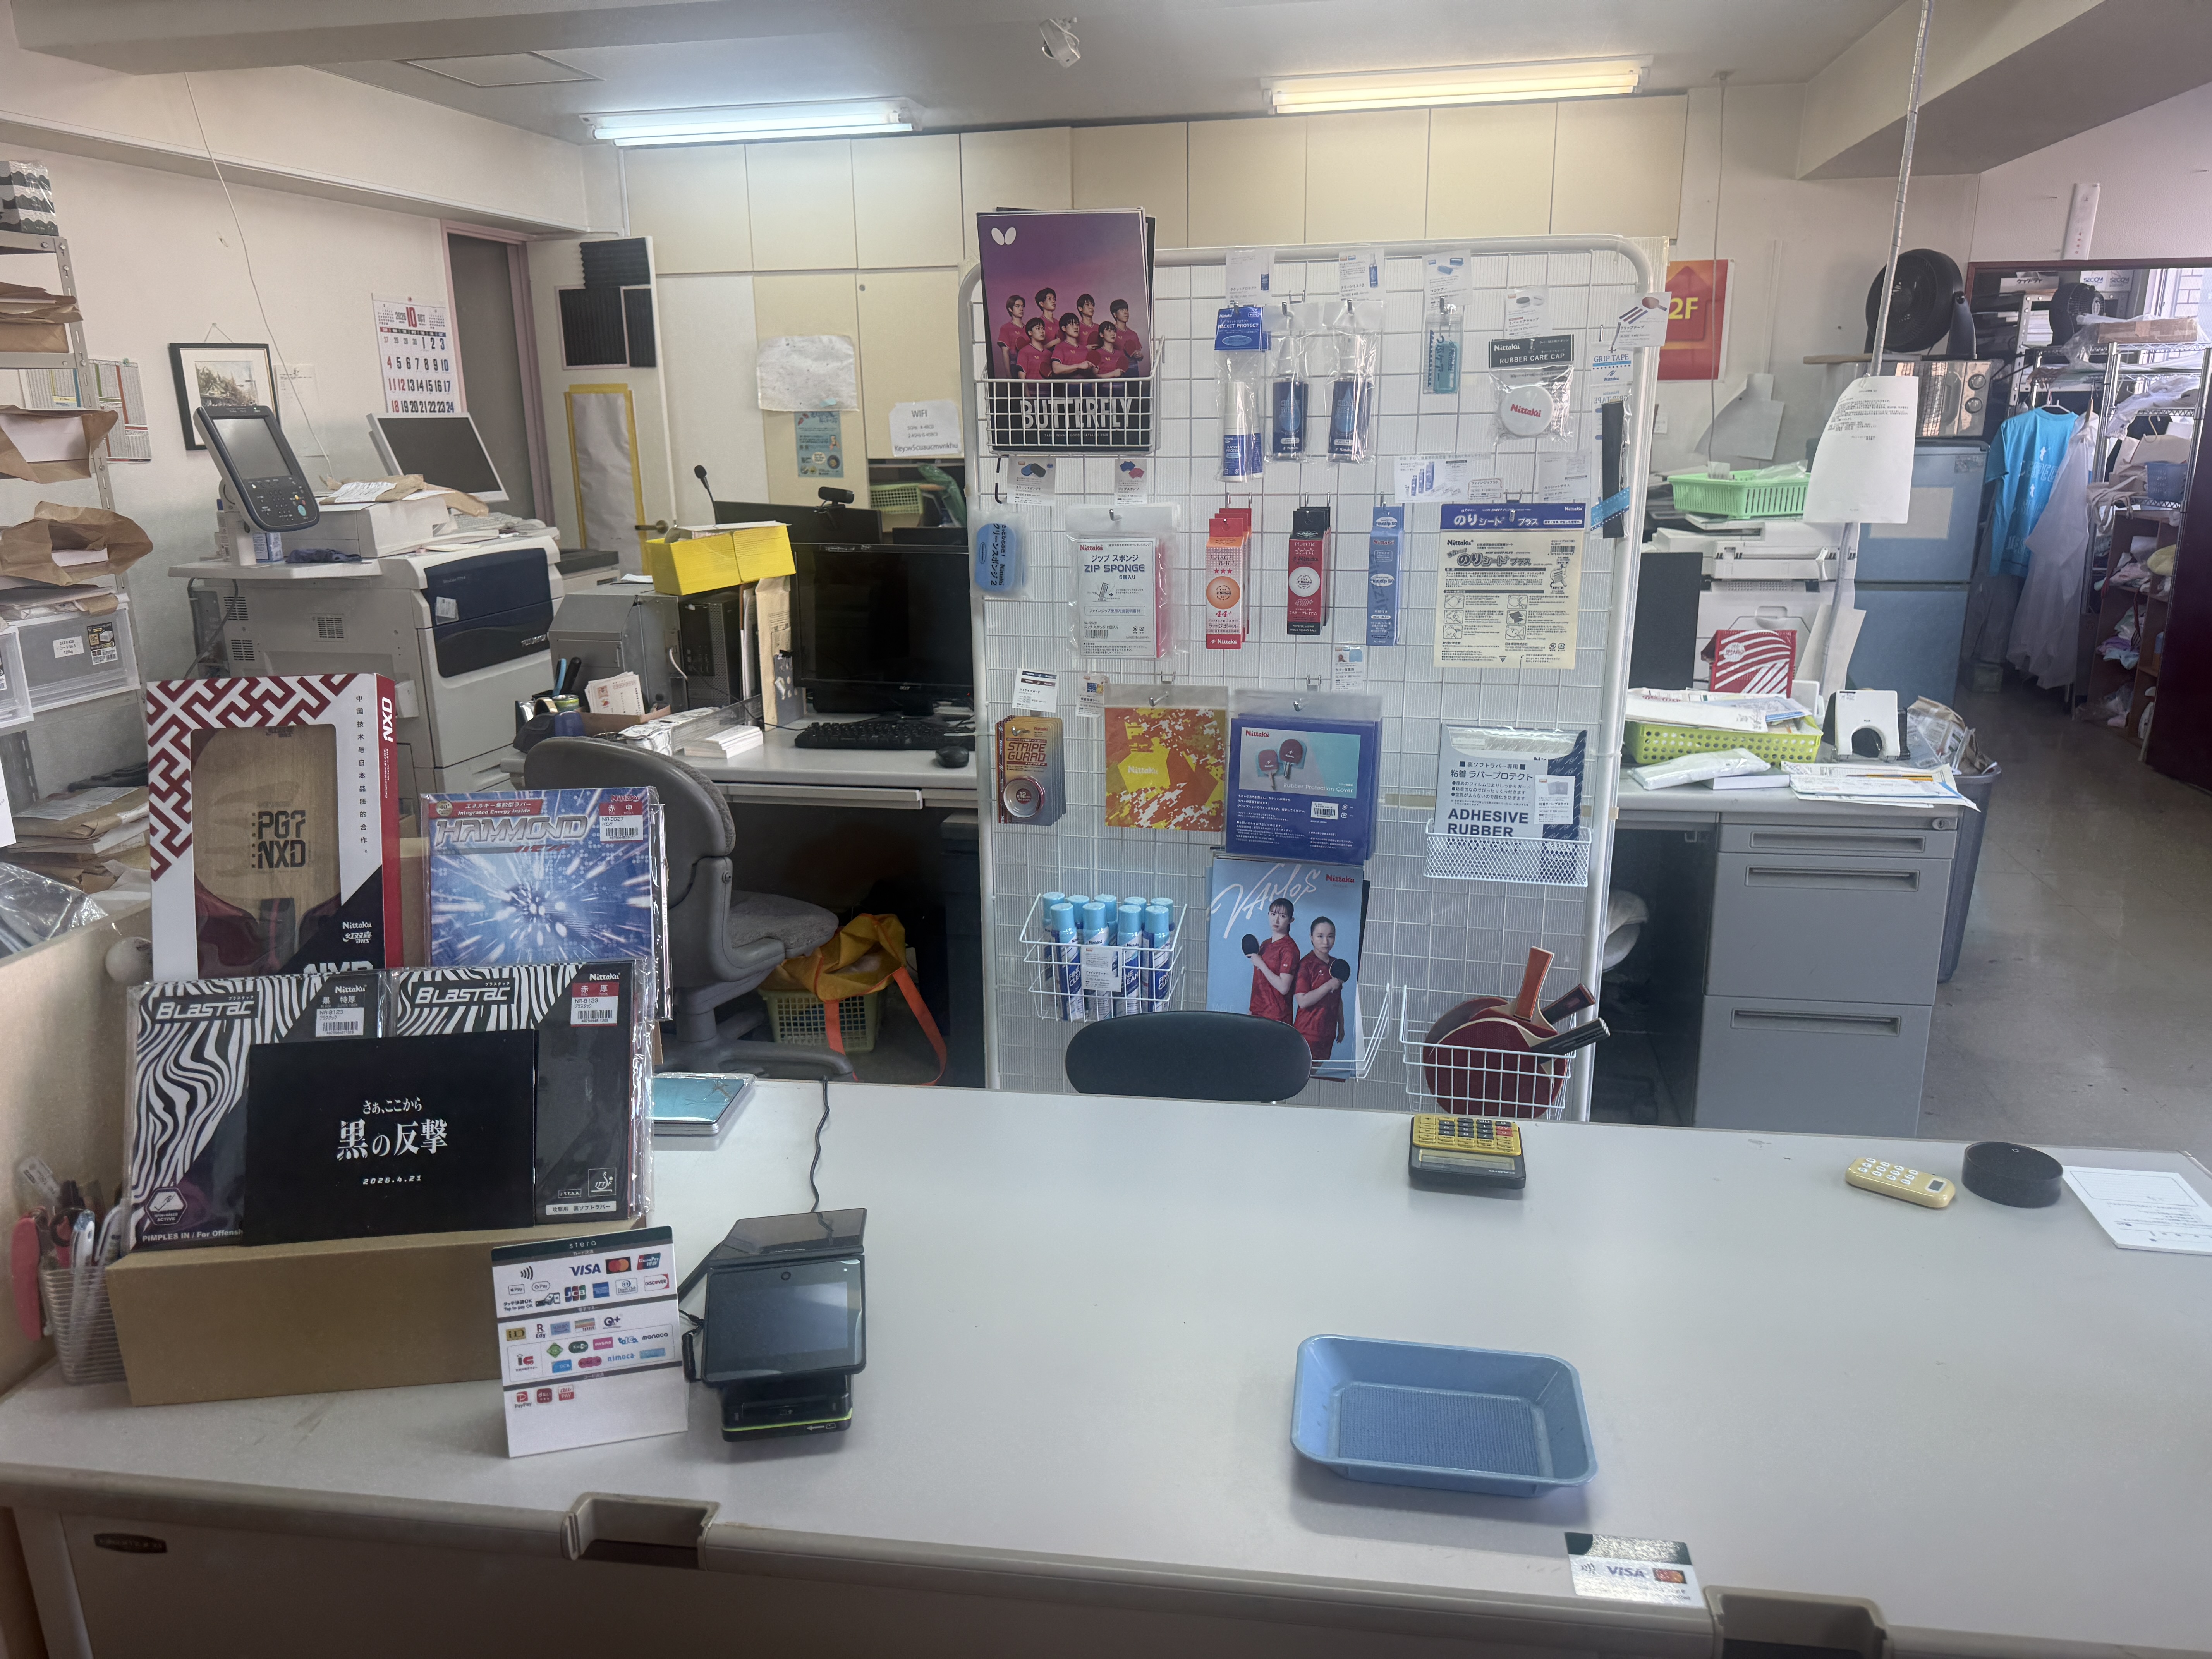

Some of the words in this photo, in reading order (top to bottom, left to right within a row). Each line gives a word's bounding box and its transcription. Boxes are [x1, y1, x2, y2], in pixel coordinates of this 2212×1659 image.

[1668, 297, 1698, 319] 2F
[406, 307, 417, 327] 10
[422, 337, 425, 349] 1
[431, 337, 435, 349] 2
[440, 338, 445, 350] 3
[387, 356, 392, 369] 4
[397, 357, 402, 369] 5
[406, 357, 411, 369] 6
[415, 358, 419, 369] 7
[424, 358, 429, 370] 8
[433, 359, 438, 371] 9
[441, 359, 449, 371] 10
[1500, 356, 1527, 364] RUBBER
[389, 378, 396, 391] 11
[398, 379, 405, 391] 12
[407, 379, 415, 391] 13
[416, 380, 424, 391] 14
[426, 380, 433, 392] 15
[434, 380, 442, 392] 16
[444, 380, 450, 392] 17
[392, 400, 399, 412] 18
[401, 400, 408, 413] 19
[409, 400, 419, 413] 20
[419, 401, 426, 413] 21
[428, 401, 436, 413] 22
[437, 401, 445, 413] 23
[446, 402, 454, 413] 24
[1510, 404, 1541, 418] Nittaku
[912, 410, 927, 418] WIFI
[1020, 398, 1132, 429] BUTTERFLY
[1518, 518, 1538, 526] プラス
[1510, 558, 1532, 566] プラス
[1084, 564, 1100, 572] ZIP
[1104, 564, 1145, 573] SPONGE
[382, 697, 393, 742] NXD
[1008, 742, 1046, 752] STRIPE
[1008, 752, 1046, 762] GUARD
[1128, 766, 1158, 775] Nittaku
[1468, 762, 1518, 770] 裏ソフトラバー専用
[1451, 769, 1466, 778] 粘着
[1469, 770, 1533, 781] ラバープロテクト
[1448, 808, 1528, 824] ADHESIVE
[1447, 823, 1513, 837] RUBBER
[258, 840, 306, 869] NXD
[1326, 874, 1355, 883] Nittaku
[342, 921, 372, 929] Nittaku
[335, 985, 366, 993] Nittaku
[340, 995, 356, 1003] 特厚
[362, 1097, 423, 1115] さあ、ここから
[336, 1118, 448, 1161] 黒の反撃
[363, 1175, 422, 1185] 2026.4.21
[574, 1203, 611, 1212] 裏ソフトラバー
[142, 1233, 179, 1242] PIMPLES
[569, 1240, 597, 1250] stera
[568, 1263, 601, 1277] VISA
[565, 1290, 586, 1298] JCB
[608, 1353, 635, 1362] nimoca
[1606, 1565, 1645, 1578] VISA
